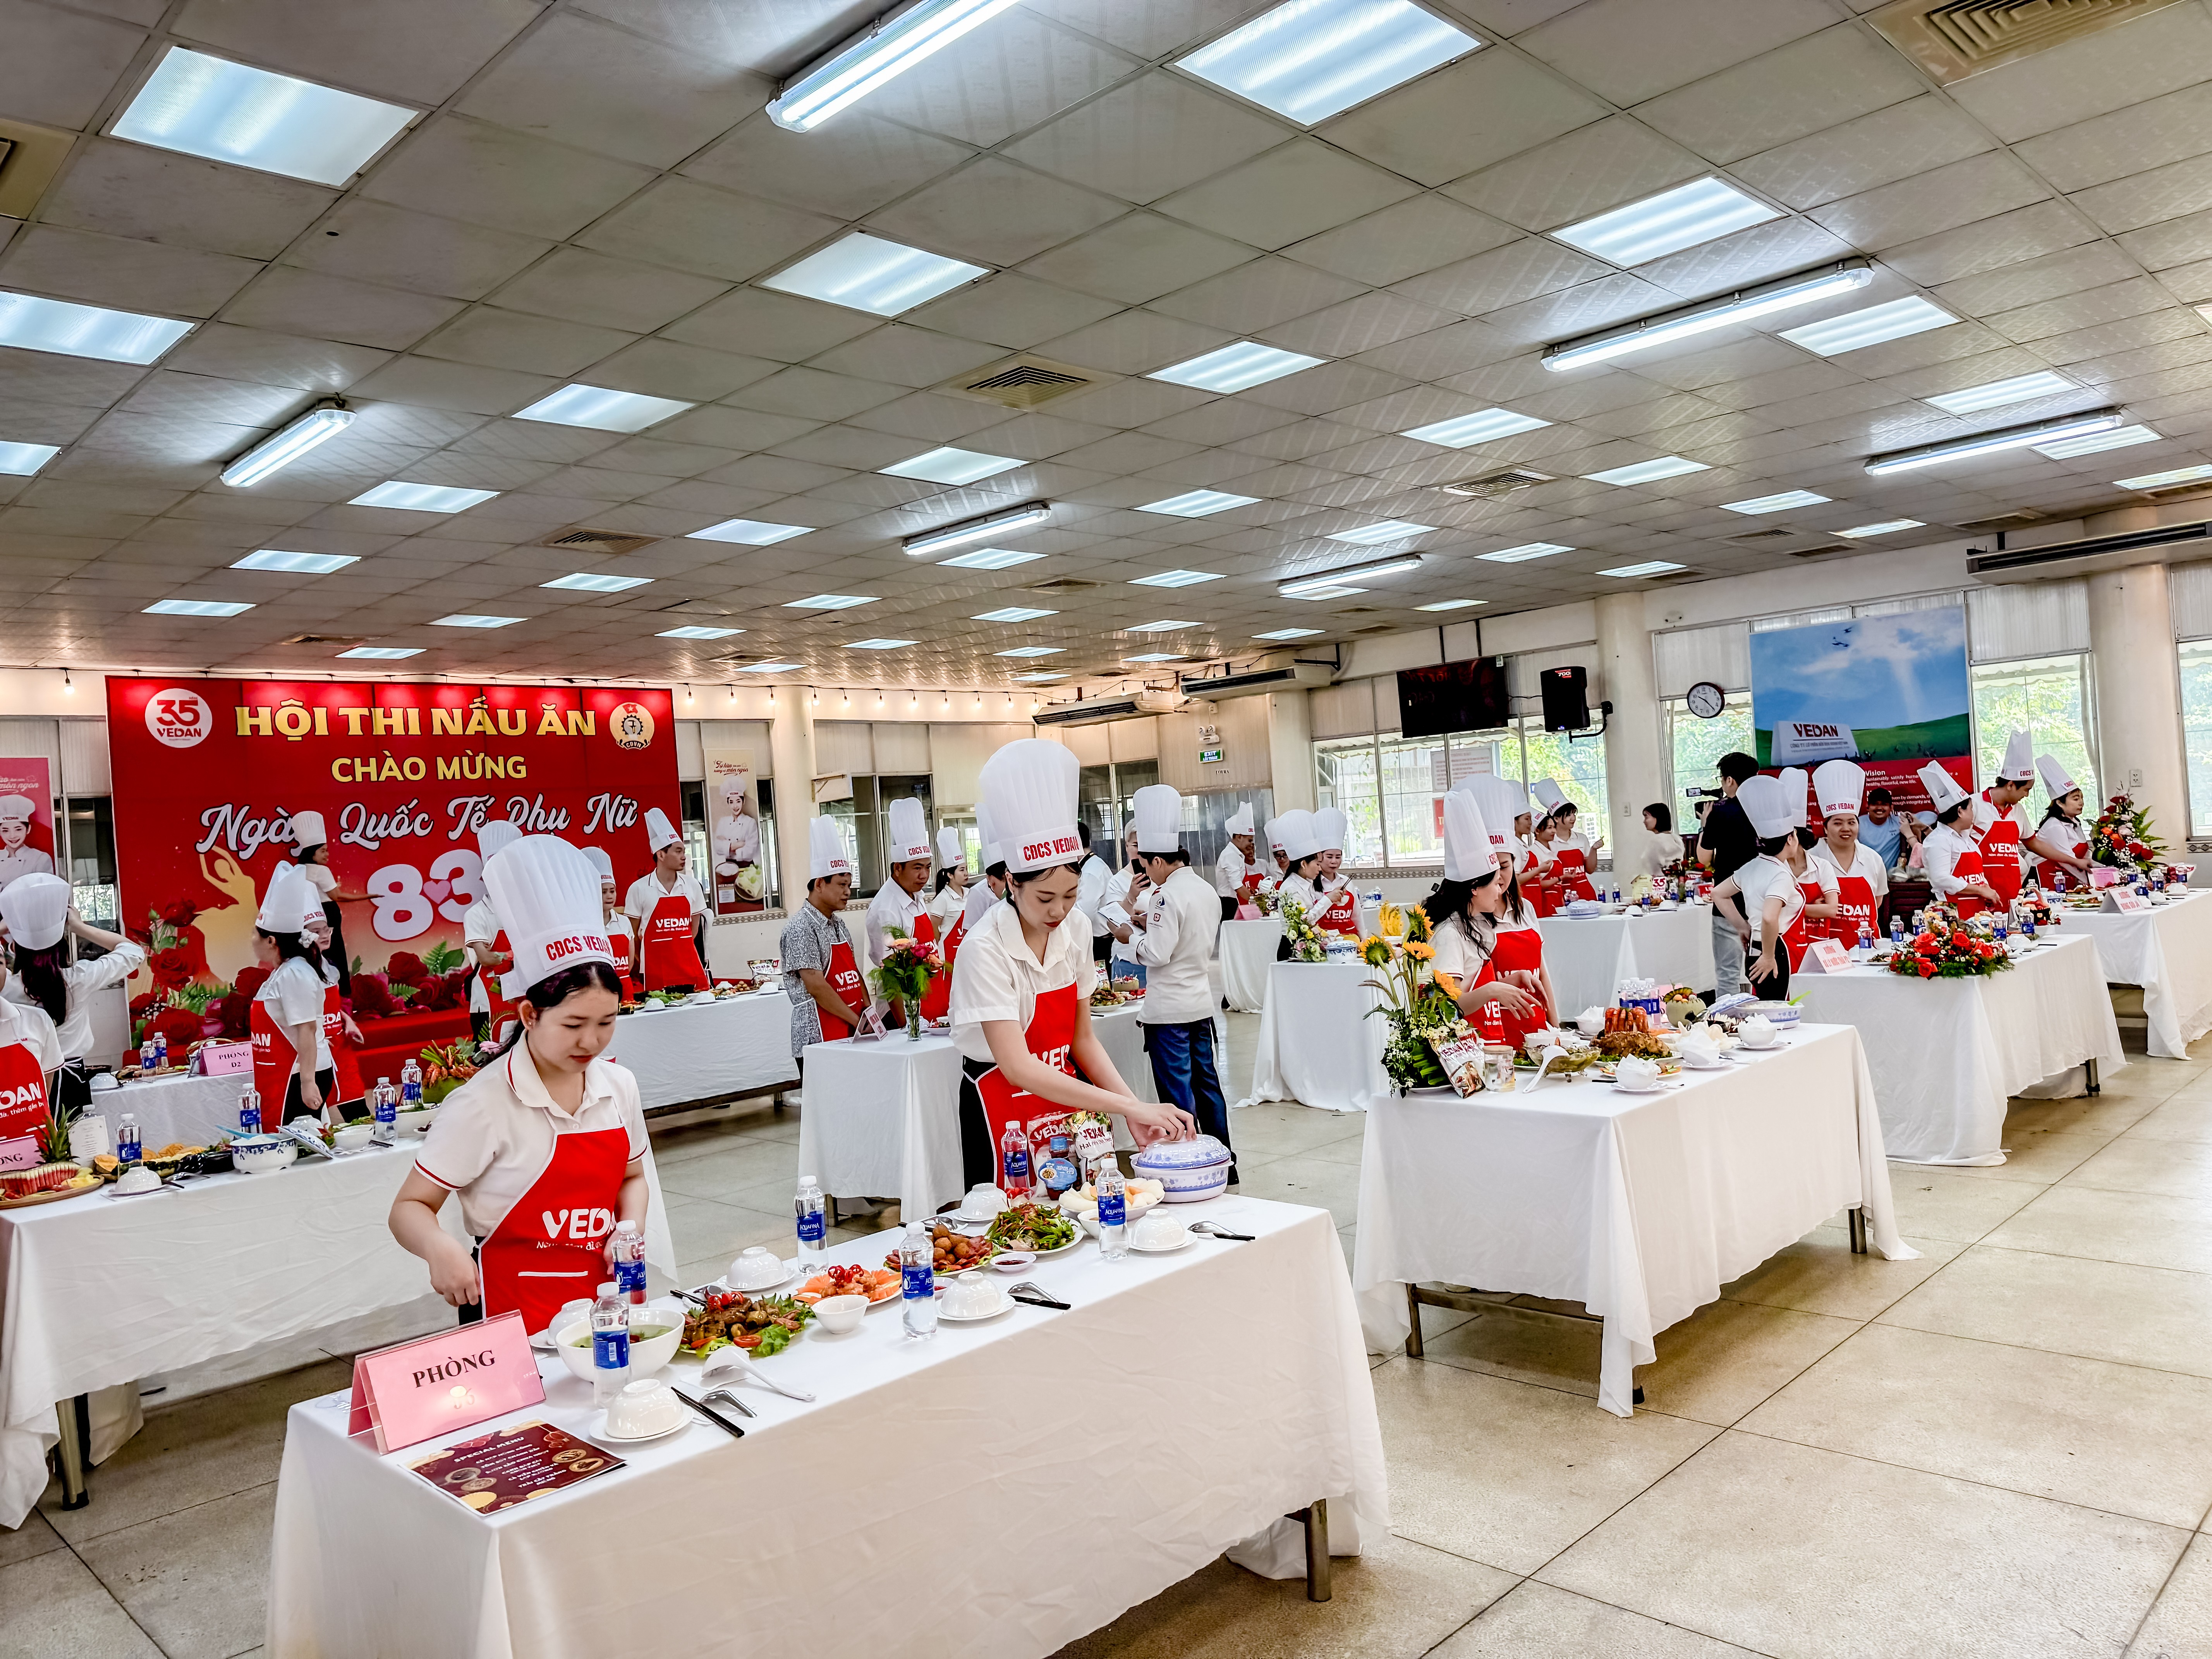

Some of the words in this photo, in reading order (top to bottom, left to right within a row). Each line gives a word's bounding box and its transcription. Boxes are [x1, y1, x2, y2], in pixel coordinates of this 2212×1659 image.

[156, 700, 200, 726] 35
[235, 698, 329, 741] HỘI
[338, 707, 421, 735] THI
[431, 696, 527, 736] NẤU
[536, 704, 596, 736] ĂN
[157, 728, 201, 737] VEDAN
[1793, 723, 1839, 737] VEDAN
[331, 750, 426, 782] CHÀO
[437, 750, 527, 780] MỪNG
[340, 799, 433, 850] Quốc
[447, 794, 495, 840] Tế
[583, 793, 638, 834] Nữ
[908, 847, 922, 856] CDCS
[1024, 842, 1052, 861] CDCS
[1052, 836, 1080, 854] VEDAN
[1489, 835, 1504, 844] DAN
[830, 860, 844, 868] CDCS
[1653, 878, 1665, 887] 35
[656, 917, 689, 928] VEDAN
[546, 936, 583, 961] CDCS
[582, 936, 612, 957] VEDAN
[835, 970, 859, 986] VED
[542, 1208, 617, 1239] VED
[412, 1349, 496, 1388] PHÒNG
[454, 1446, 496, 1462] SPECIAL
[496, 1437, 524, 1448] MENU
